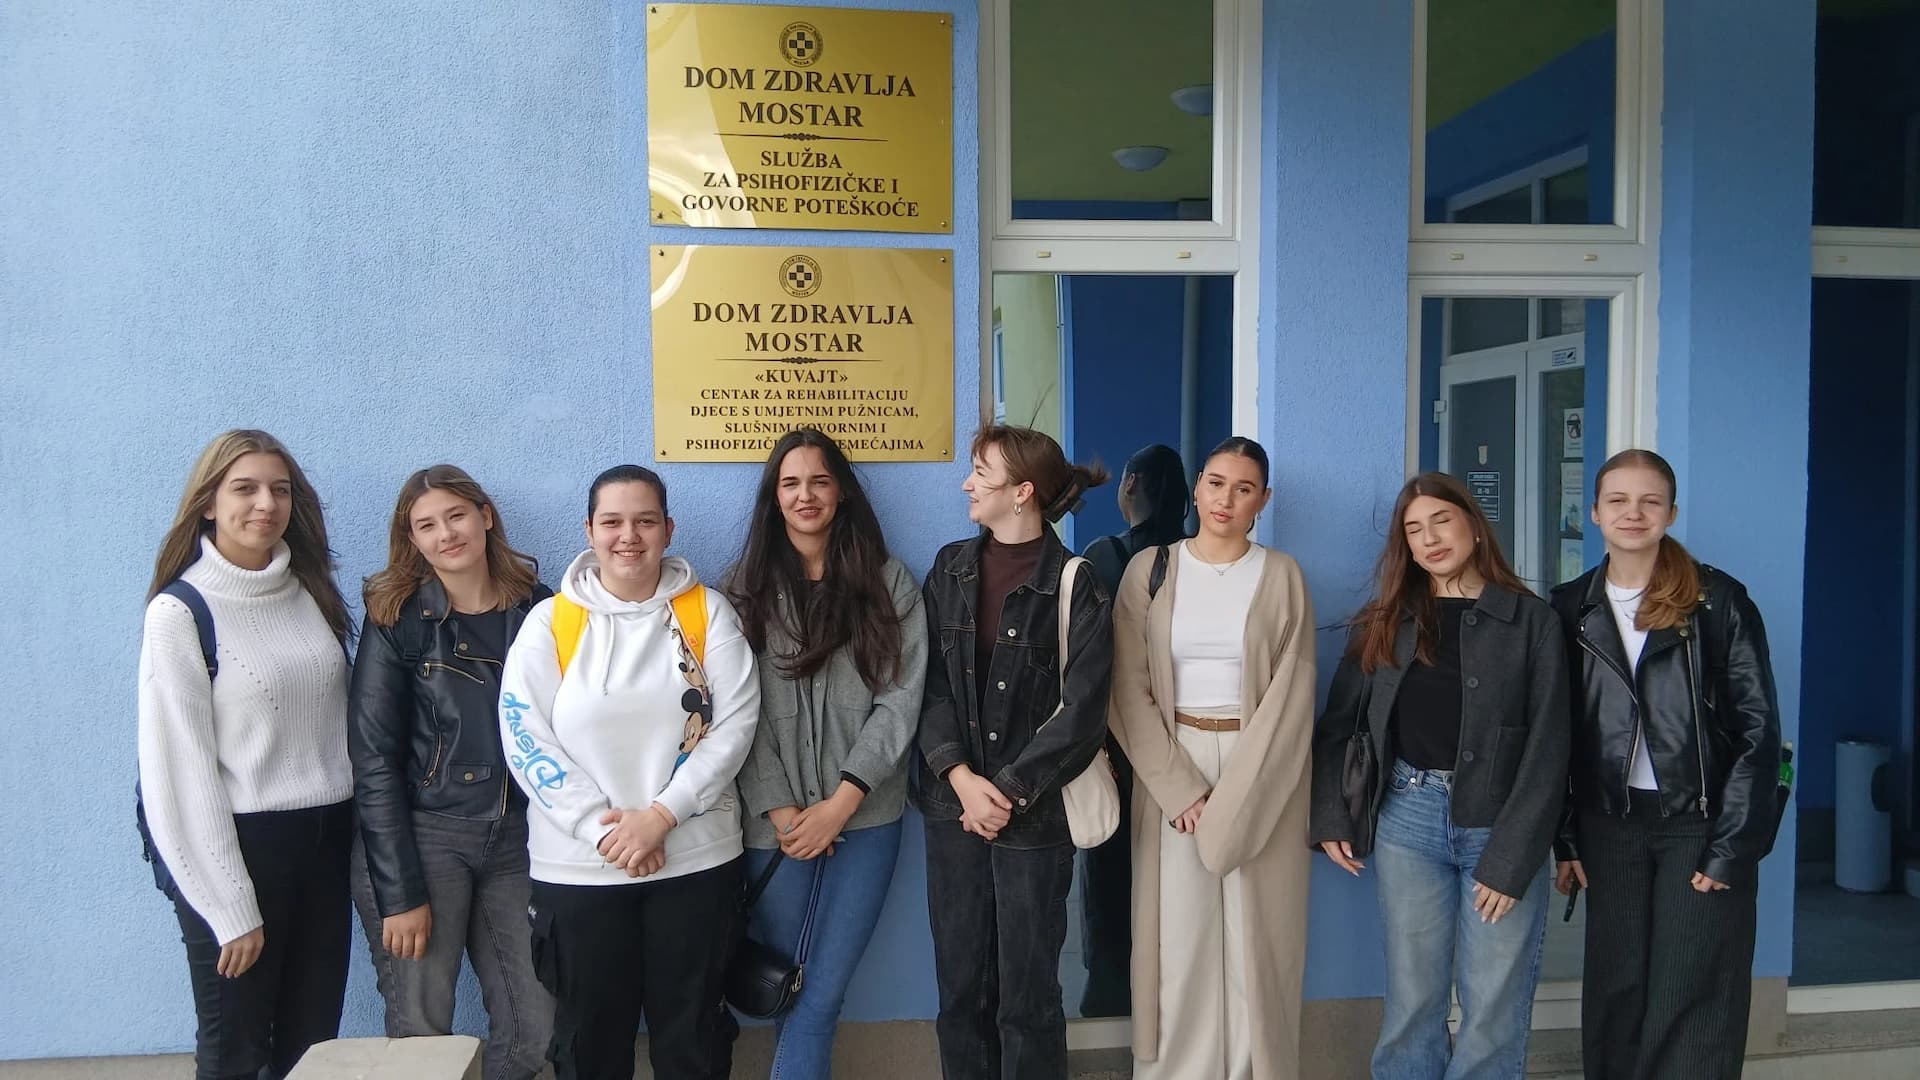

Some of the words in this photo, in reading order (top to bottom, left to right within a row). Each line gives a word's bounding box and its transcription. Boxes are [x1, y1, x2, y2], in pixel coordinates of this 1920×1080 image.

[683, 66, 756, 90] DOM
[763, 69, 916, 97] ZDRAVLJA
[739, 101, 864, 128] MOSTAR
[760, 148, 842, 169] SLUŽBA
[703, 172, 731, 188] ZA
[736, 172, 886, 194] PSIHOFIZIČKE
[891, 178, 899, 194] I
[682, 194, 788, 214] GOVORNE
[794, 196, 919, 217] POTEŠKOĆE
[692, 302, 761, 323] DOM
[770, 303, 914, 325] ZDRAVLJA
[745, 332, 864, 352] MOSTAR
[700, 389, 760, 400] CENTAR
[763, 389, 783, 400] ZA
[786, 389, 909, 401] REHABILITACIJU
[690, 406, 739, 418] DJECE
[742, 406, 751, 418] S
[754, 406, 834, 418] UMJETNIM
[838, 404, 919, 419] PUŽNICAM,
[724, 420, 792, 434] SLUŠNIM
[881, 423, 887, 434] I
[685, 436, 778, 451] PSIHOFIZIČ
[837, 436, 925, 451] EMEĆAJIMA
[502, 691, 568, 809] Disney
